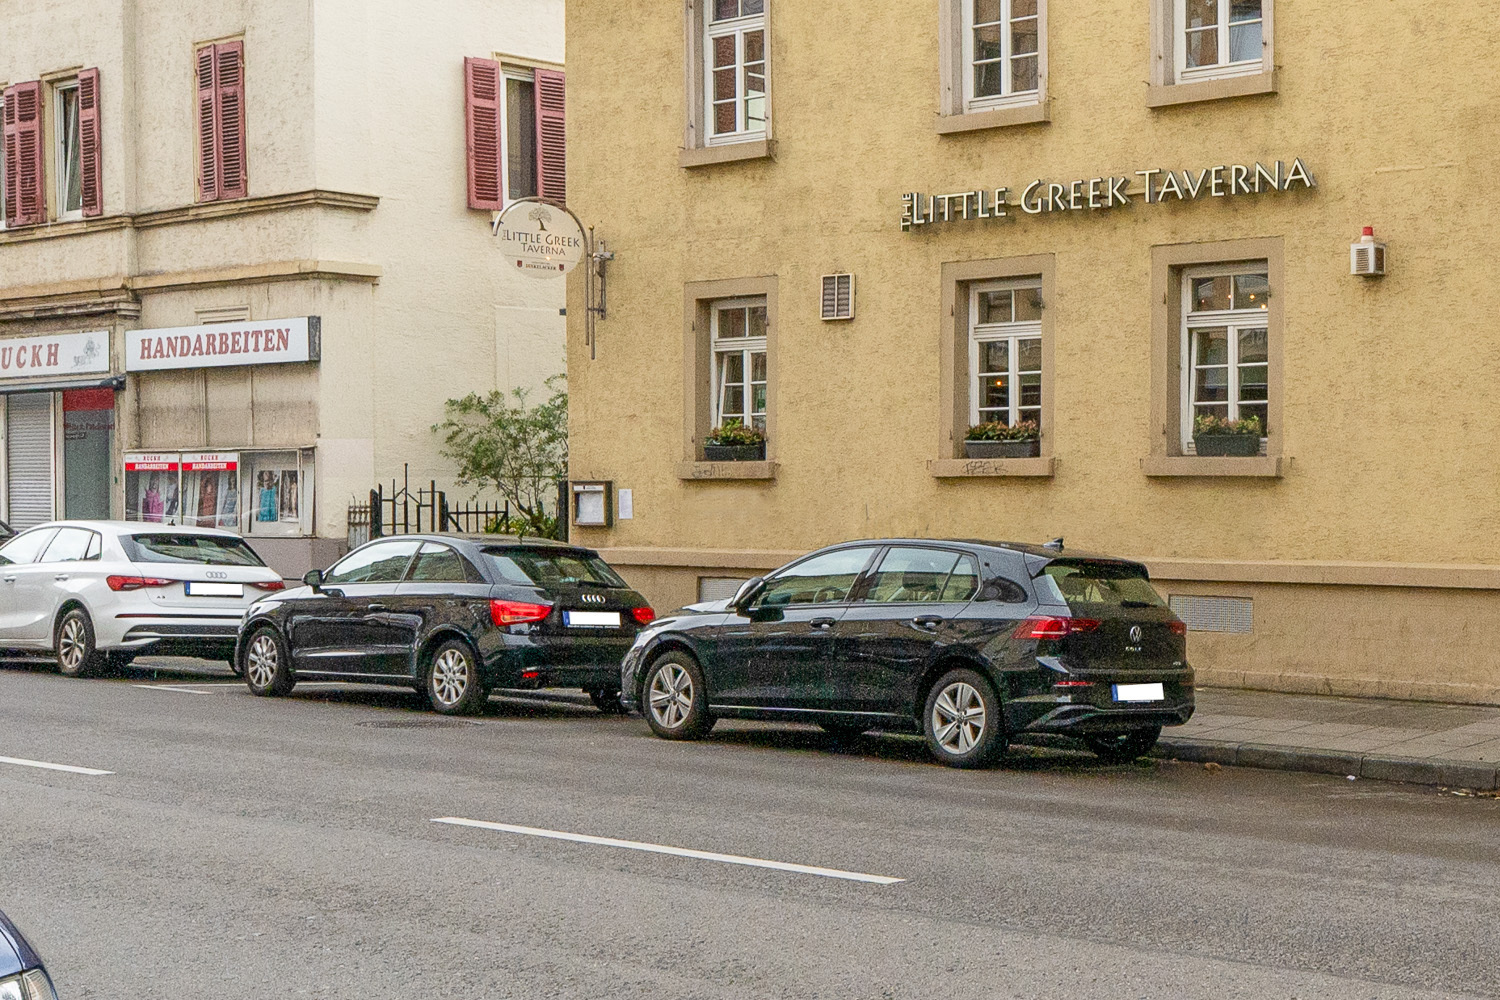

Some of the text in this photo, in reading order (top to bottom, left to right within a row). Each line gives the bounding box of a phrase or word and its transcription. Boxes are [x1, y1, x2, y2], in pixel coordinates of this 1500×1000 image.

[900, 157, 1312, 232] THE LITTLE GREEK TAVERNA
[507, 230, 541, 243] LITTLE
[545, 234, 580, 247] GREEK
[521, 243, 566, 255] TAVERNA
[140, 328, 291, 360] HANDARBEITEN
